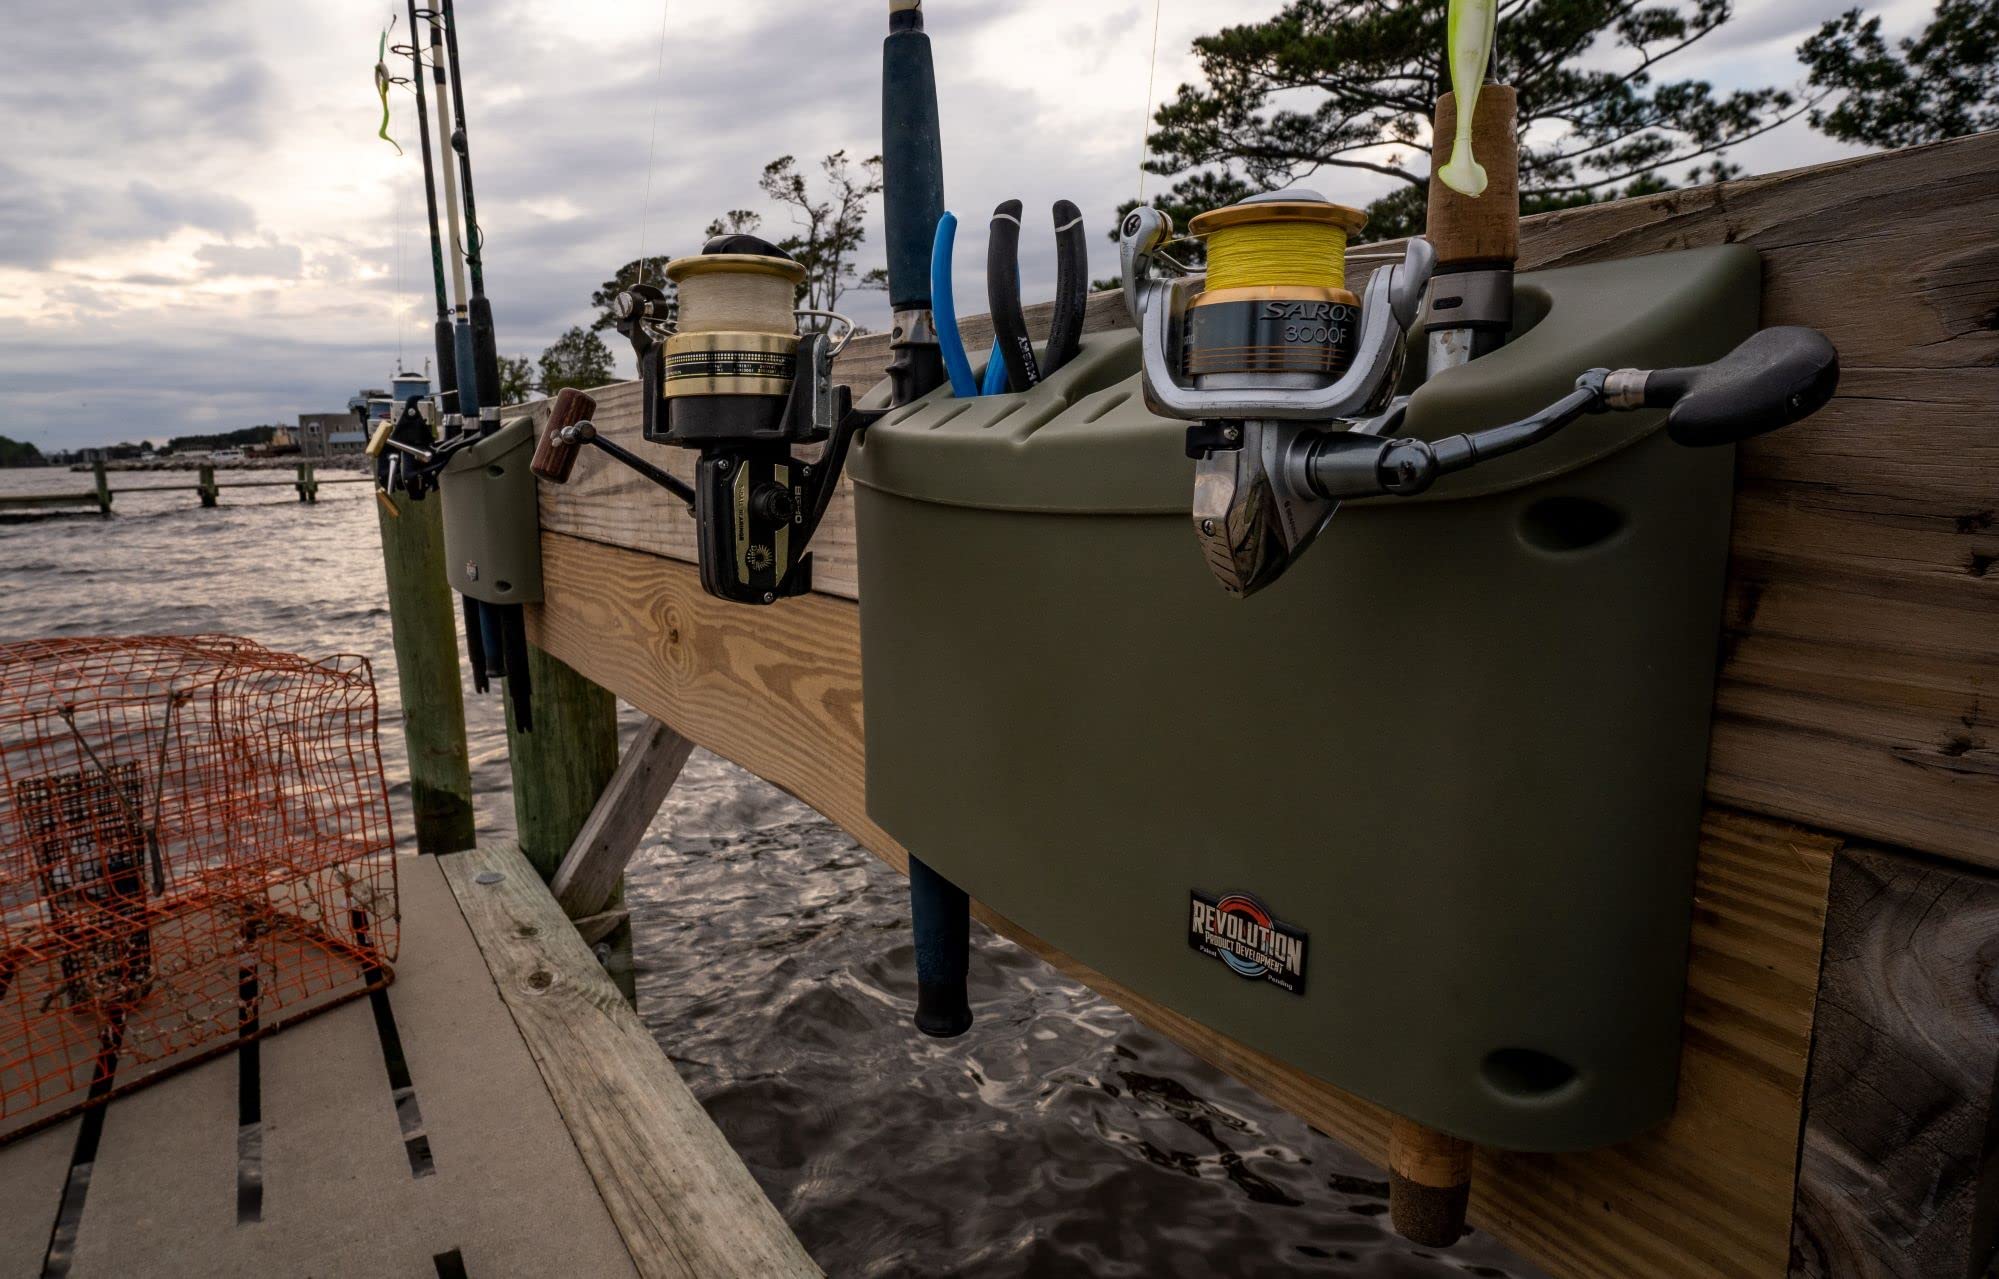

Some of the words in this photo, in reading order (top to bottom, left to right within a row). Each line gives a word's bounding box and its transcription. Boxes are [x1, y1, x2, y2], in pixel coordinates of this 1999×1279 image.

[1259, 301, 1357, 323] SAROS
[1284, 325, 1348, 344] 3000F
[1192, 899, 1303, 976] REVOLUTION
[1205, 930, 1235, 953] PRODUCT
[1235, 942, 1284, 975] DEVELOPMENT
[1199, 945, 1217, 957] Patent
[1267, 974, 1293, 991] Pending
